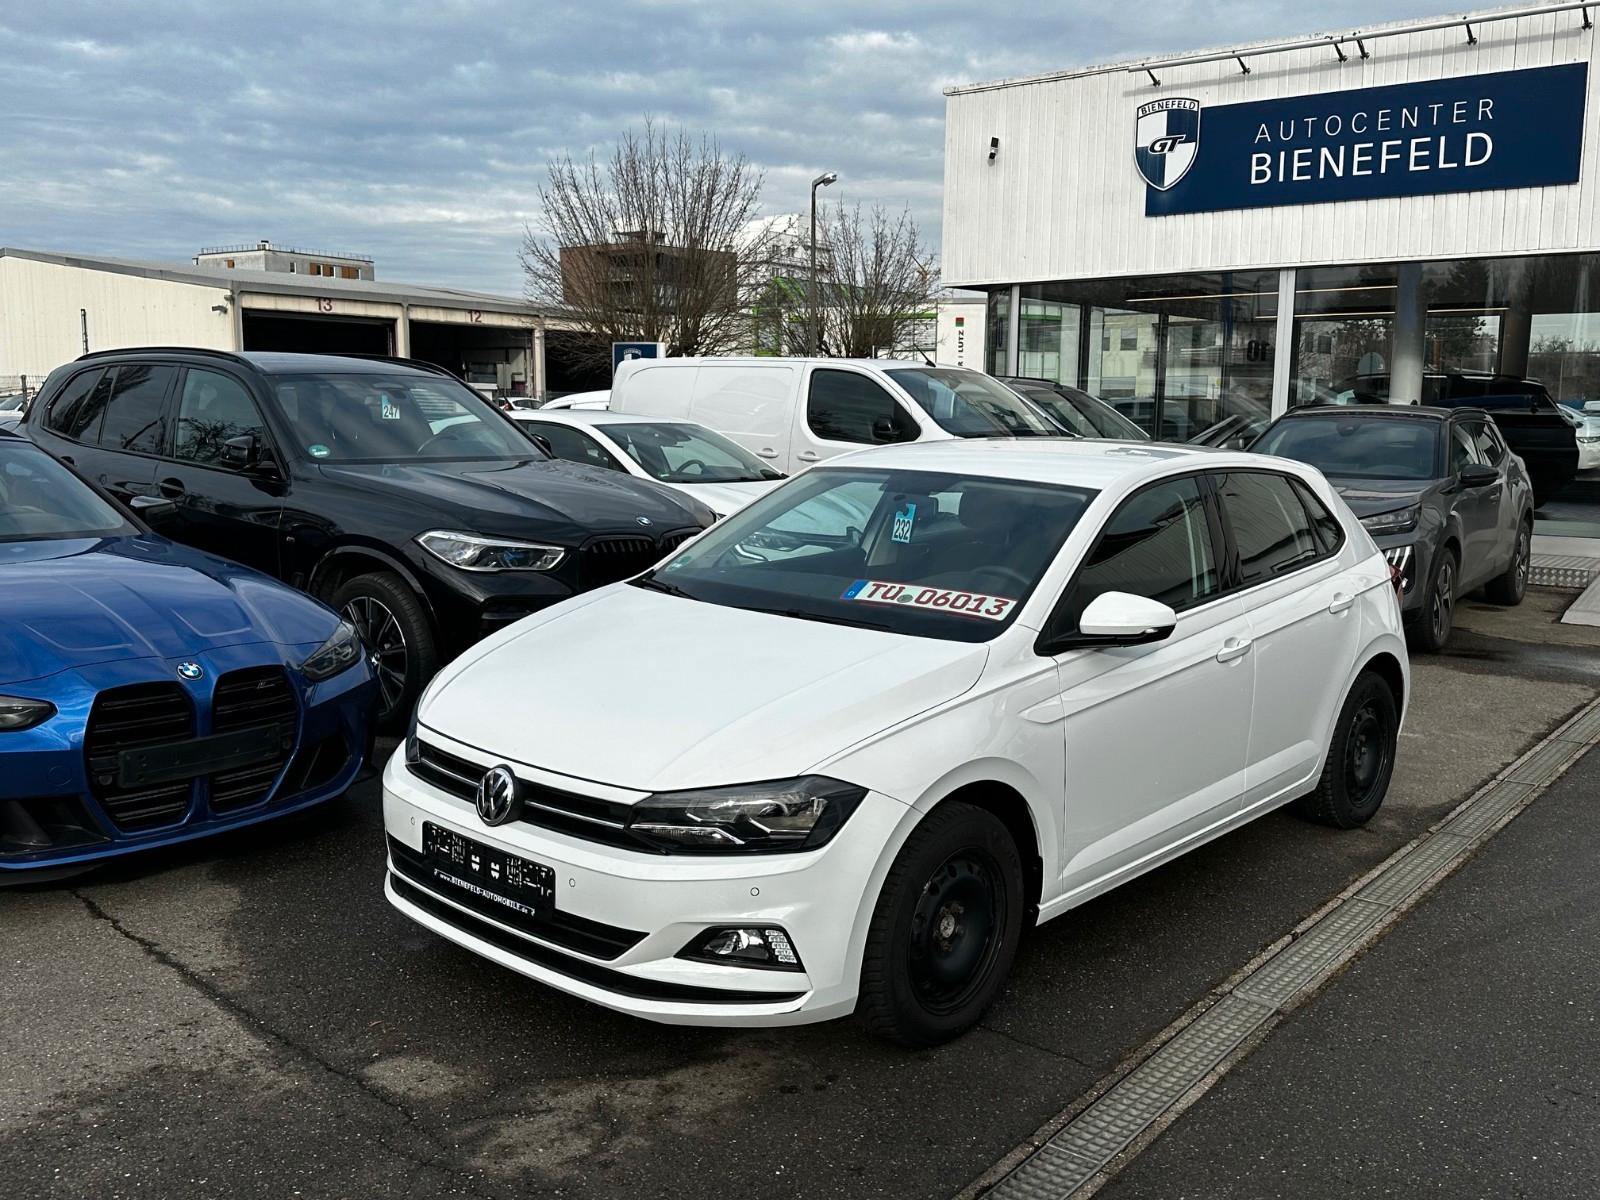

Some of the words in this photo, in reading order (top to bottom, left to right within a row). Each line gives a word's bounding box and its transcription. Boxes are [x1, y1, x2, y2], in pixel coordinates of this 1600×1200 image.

[1141, 100, 1195, 115] BIENEFELD
[1255, 99, 1494, 143] AUTOCENTER
[1149, 135, 1186, 153] GT
[1251, 132, 1493, 184] BIENEFELD
[315, 299, 333, 312] 13
[467, 310, 482, 323] 12
[893, 519, 911, 540] 232
[914, 589, 1009, 616] 06013
[439, 873, 528, 913] www.BIENEFELD-AUTOMOBILE.de
